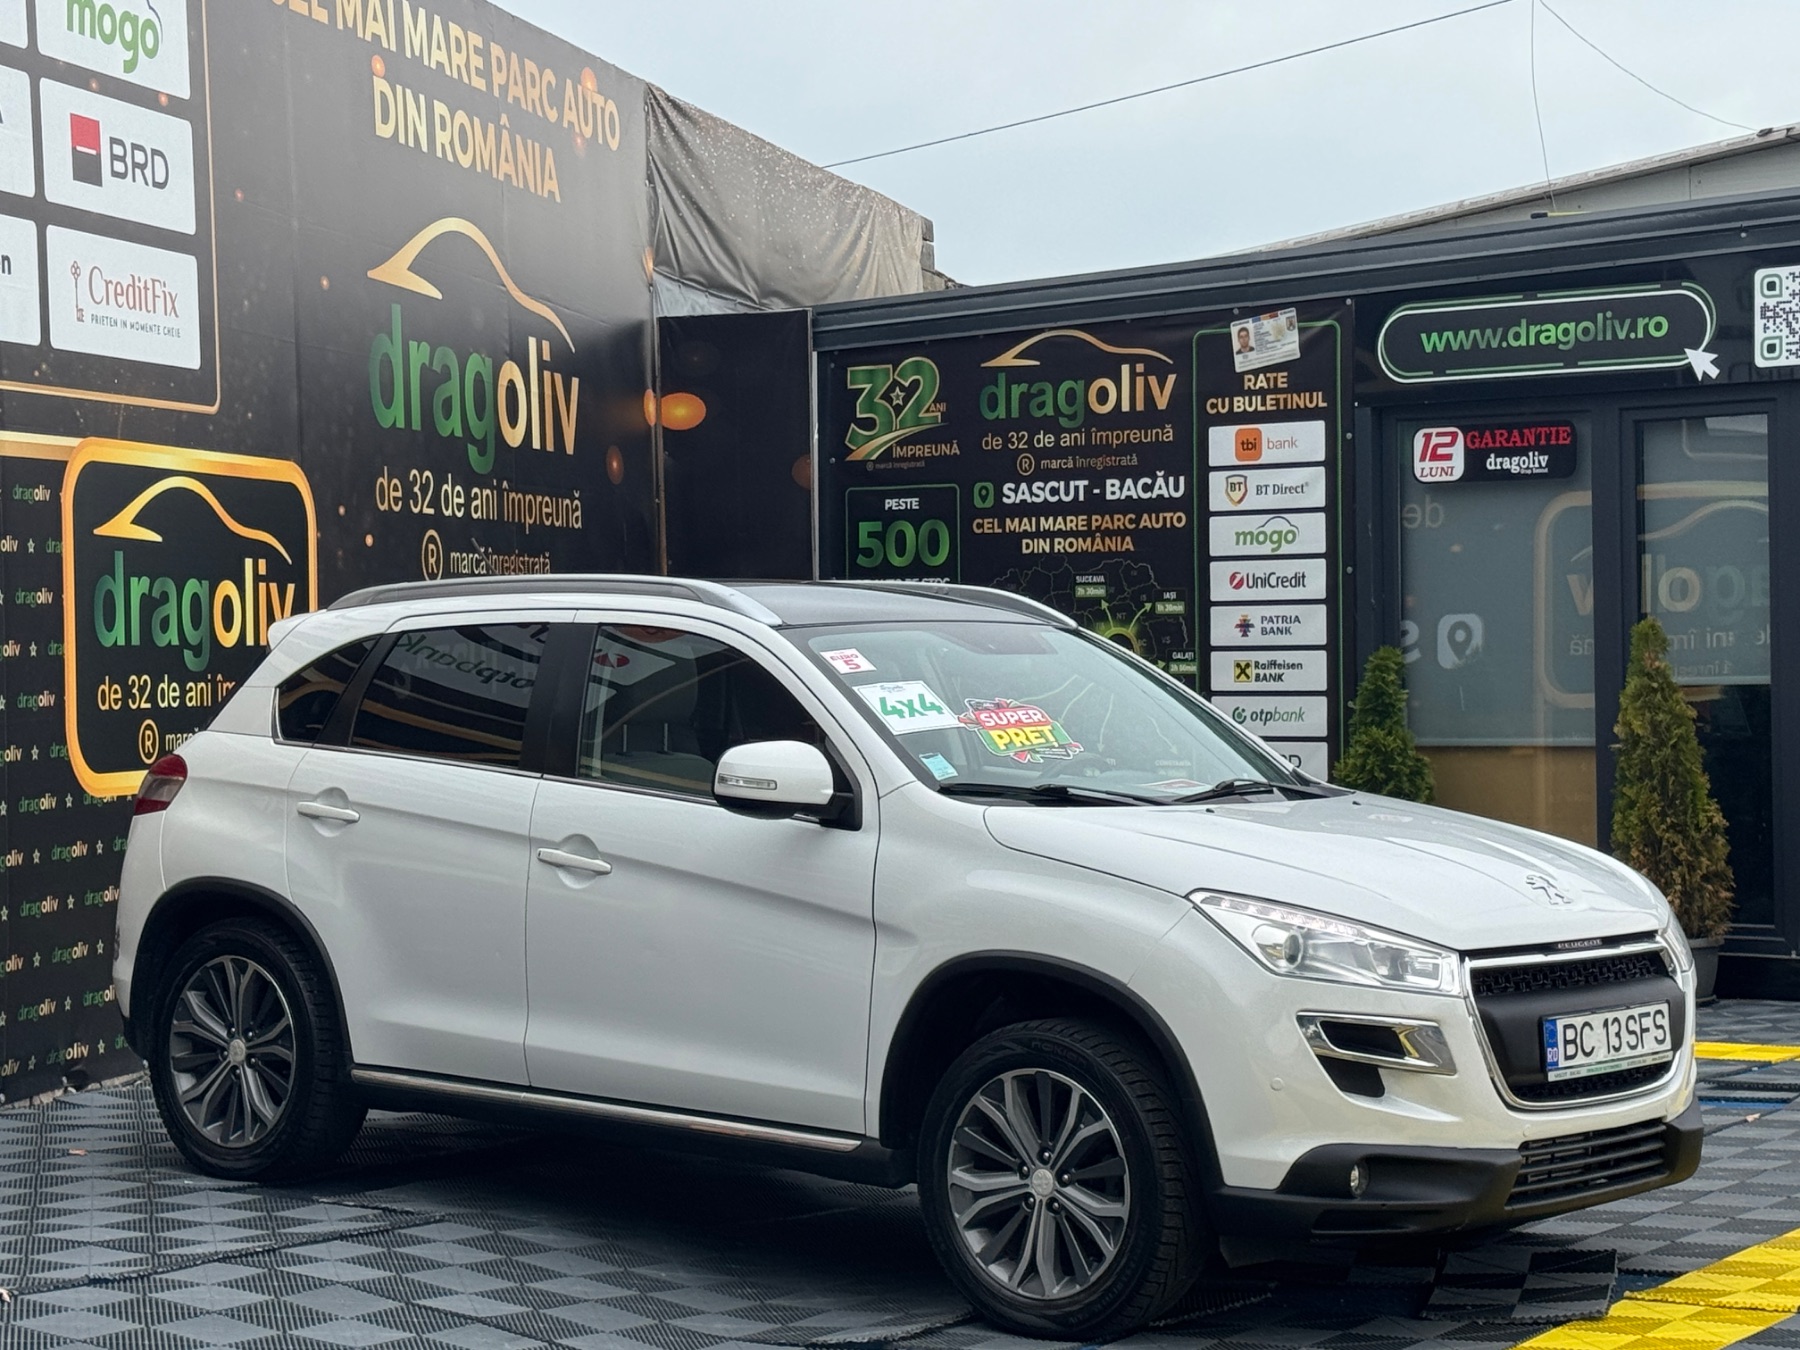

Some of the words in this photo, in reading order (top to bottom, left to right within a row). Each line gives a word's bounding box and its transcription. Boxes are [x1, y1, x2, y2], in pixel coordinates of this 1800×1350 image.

[67, 0, 160, 74] mogo
[402, 0, 486, 92] MARE
[490, 42, 558, 123] PARC
[563, 79, 620, 151] AUTO
[373, 75, 428, 153] DIN
[434, 99, 561, 203] ROMÂNIA
[109, 136, 169, 190] BRD
[89, 266, 179, 319] CreditFix
[91, 313, 117, 328] PRIETEN
[130, 321, 160, 336] MOMENTE
[1420, 310, 1669, 354] www.dragoliv.ro
[368, 303, 580, 474] dragoliv
[1244, 372, 1288, 390] RATE
[844, 356, 940, 450] 32
[929, 402, 947, 413] ANI
[979, 363, 1177, 429] dragoliv
[1206, 397, 1230, 414] CU
[1233, 391, 1328, 413] BULETINUL
[982, 433, 1002, 450] de
[1007, 431, 1028, 449] 32
[1034, 430, 1055, 448] de
[1060, 428, 1085, 447] ani
[1091, 424, 1173, 449] împreună
[1240, 437, 1257, 452] tbi
[1267, 436, 1298, 451] bank
[1419, 431, 1459, 463] 12
[1466, 426, 1572, 449] GARANTIE
[892, 440, 960, 459] ÎMPREUNĂ
[1041, 456, 1073, 470] marcă
[1076, 454, 1138, 471] înregistrată
[1419, 466, 1455, 478] LUNI
[1486, 451, 1549, 474] dragoliv
[12, 484, 51, 504] dragoliv
[1002, 480, 1089, 504] SASCUT
[1105, 470, 1185, 501] BACĂU
[1229, 482, 1244, 493] BT
[1256, 484, 1270, 496] BT
[376, 466, 402, 512] de
[409, 469, 435, 515] 32
[441, 473, 464, 518] de
[471, 479, 498, 521] ani
[503, 480, 582, 534] împreună
[885, 498, 919, 511] PESTE
[972, 518, 1002, 535] CEL
[1005, 516, 1036, 533] MAI
[1040, 515, 1088, 532] MARE
[1092, 514, 1136, 531] PARC
[1139, 512, 1187, 530] AUTO
[45, 537, 63, 554] dra
[856, 519, 950, 567] 500
[1022, 538, 1050, 554] DIN
[1054, 532, 1135, 554] ROMÂNIA
[1235, 529, 1297, 553] mogo
[451, 546, 486, 575] marcă
[1075, 575, 1105, 584] SUCEAVA
[1246, 571, 1306, 590] UniCredit
[15, 587, 53, 608] dragoliv
[94, 550, 296, 673] dragoliv
[1261, 615, 1301, 626] PATRIA
[1261, 626, 1293, 636] BANK
[829, 653, 859, 662] EURO
[843, 659, 862, 670] 5
[1254, 659, 1303, 671] Raiffeisen
[1254, 672, 1285, 683] BANK
[17, 690, 55, 711] dragoliv
[97, 675, 122, 711] de
[128, 674, 151, 710] 32
[157, 674, 180, 709] de
[186, 674, 212, 707] ani
[979, 709, 1047, 727] SUPER
[1250, 705, 1306, 727] otpbank
[18, 793, 57, 814] dragoliv
[51, 840, 88, 862] dragoliv
[20, 896, 59, 918] dragoliv
[84, 885, 120, 907] dragoliv
[52, 941, 89, 964] dragoliv
[1557, 938, 1603, 949] PEUGEOT
[18, 999, 56, 1021] dragoliv
[83, 984, 117, 1007] dragoli
[1562, 1020, 1596, 1062] BC
[1546, 1047, 1559, 1062] RO
